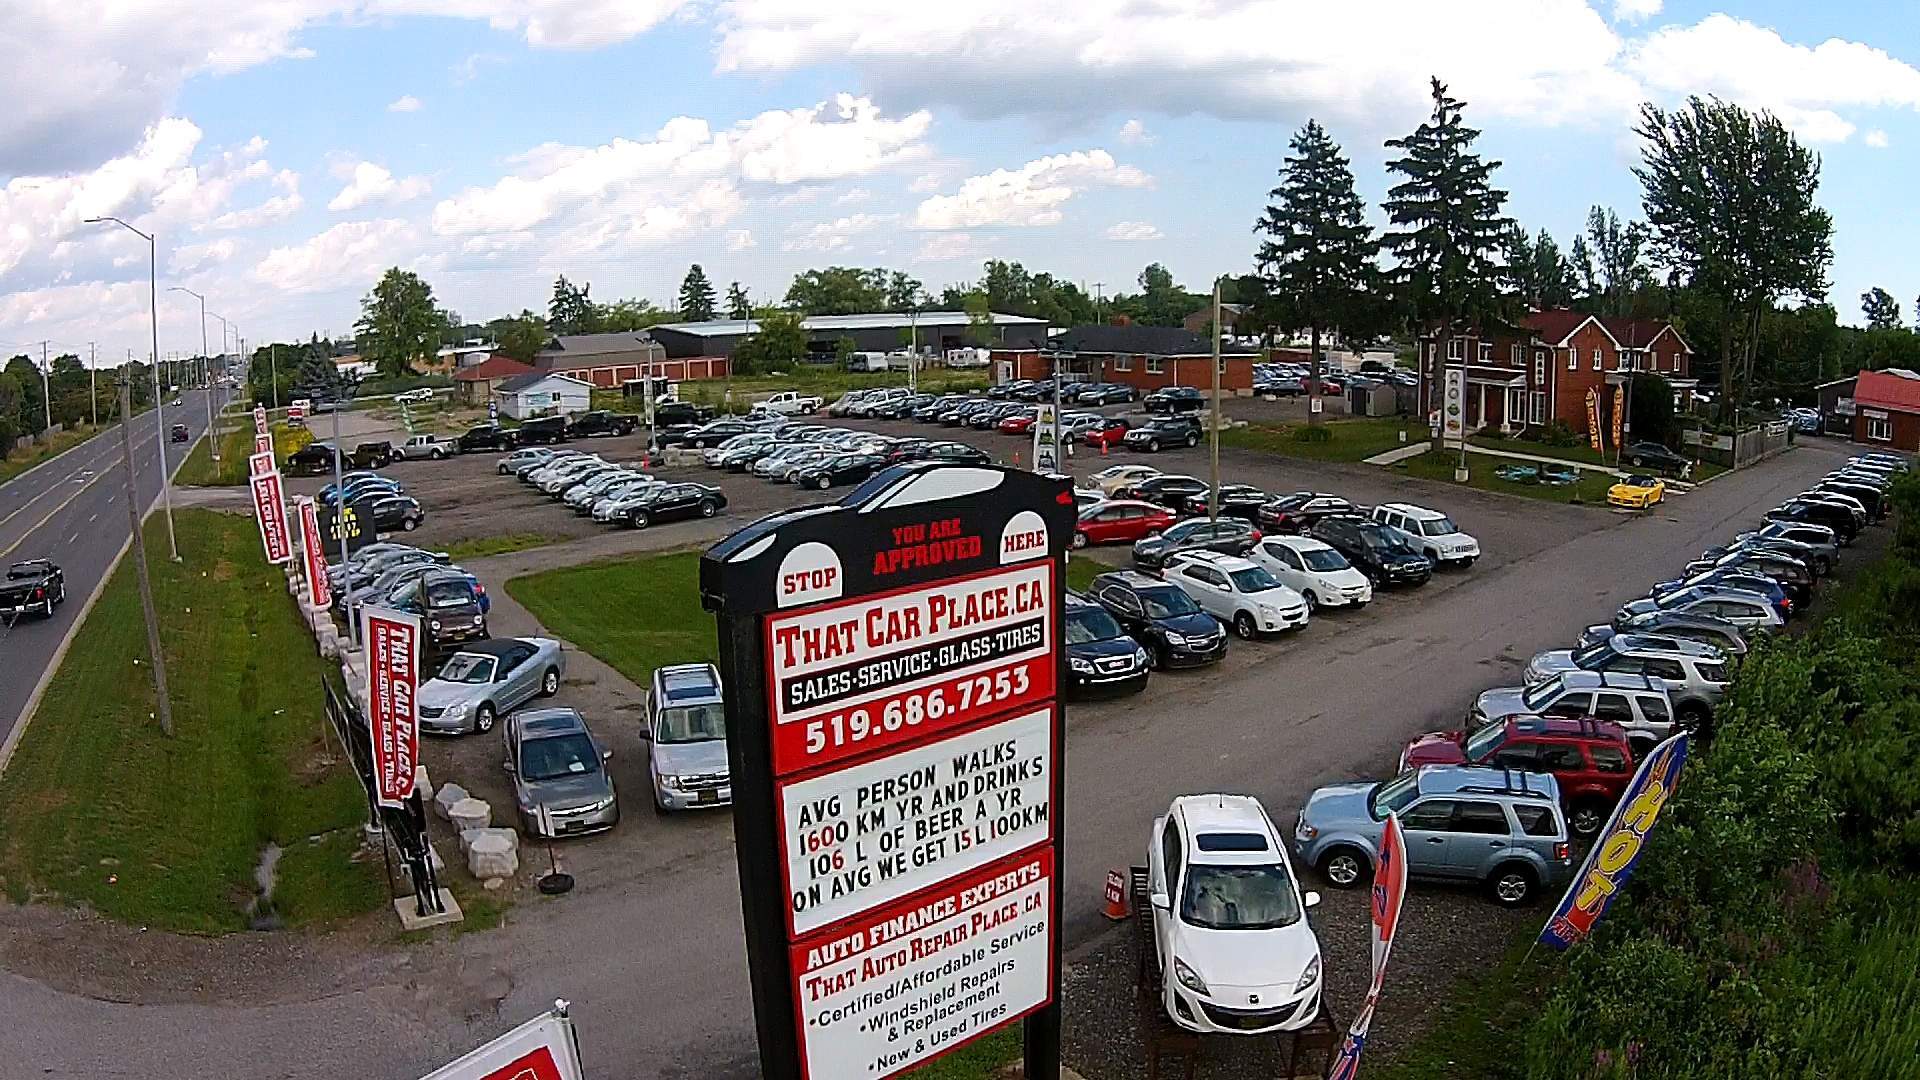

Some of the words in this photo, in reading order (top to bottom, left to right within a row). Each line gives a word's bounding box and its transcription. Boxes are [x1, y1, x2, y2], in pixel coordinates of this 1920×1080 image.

[873, 535, 982, 576] APPROVED
[891, 523, 926, 545] YOU
[929, 517, 961, 540] ARE
[1004, 530, 1045, 553] HERE
[783, 567, 837, 595] STOP
[389, 626, 411, 677] THAT
[776, 619, 859, 669] THAT
[865, 606, 922, 648] CAR
[928, 580, 1044, 635] PLACE.CA
[393, 679, 411, 717] CAR
[790, 670, 851, 705] SALES
[857, 650, 932, 688] SERVICE
[939, 635, 991, 667] GLASS
[996, 623, 1041, 652] TIRES
[806, 664, 1030, 754] 519.686.7253
[799, 794, 841, 829] AVG
[857, 764, 936, 810] PERSON
[952, 739, 1016, 779] WALKS
[799, 820, 849, 856] 1600
[856, 806, 885, 836] KM
[895, 795, 923, 821] YR
[931, 780, 969, 811] AND
[974, 756, 1043, 796] DRINKS
[793, 883, 821, 913] ON
[831, 864, 871, 900] AVG
[877, 851, 907, 881] WE
[911, 836, 947, 868] GET
[953, 828, 971, 853] 15
[974, 825, 986, 845] L
[809, 848, 845, 879] 106
[855, 841, 868, 863] L
[879, 826, 905, 853] OF
[915, 807, 964, 842] BEER
[975, 799, 987, 821] A
[996, 787, 1022, 812] YR
[1576, 780, 1669, 912] HOT
[805, 968, 857, 1002] THAT
[861, 948, 907, 982] AUTO
[909, 923, 968, 962] REPAIR
[971, 901, 1018, 937] PLACE
[806, 931, 865, 970] AUTO
[869, 895, 957, 947] FINANCE
[960, 860, 1041, 910] EXPERTS
[990, 920, 1046, 955] Service
[868, 983, 956, 1032] Windshield
[960, 959, 1016, 993] Repairs
[887, 1026, 899, 1043] &
[903, 981, 1001, 1036] Replacement
[877, 1048, 911, 1072] New
[914, 1038, 925, 1054] &
[930, 1018, 968, 1046] Used
[971, 1003, 1008, 1028] Tires
